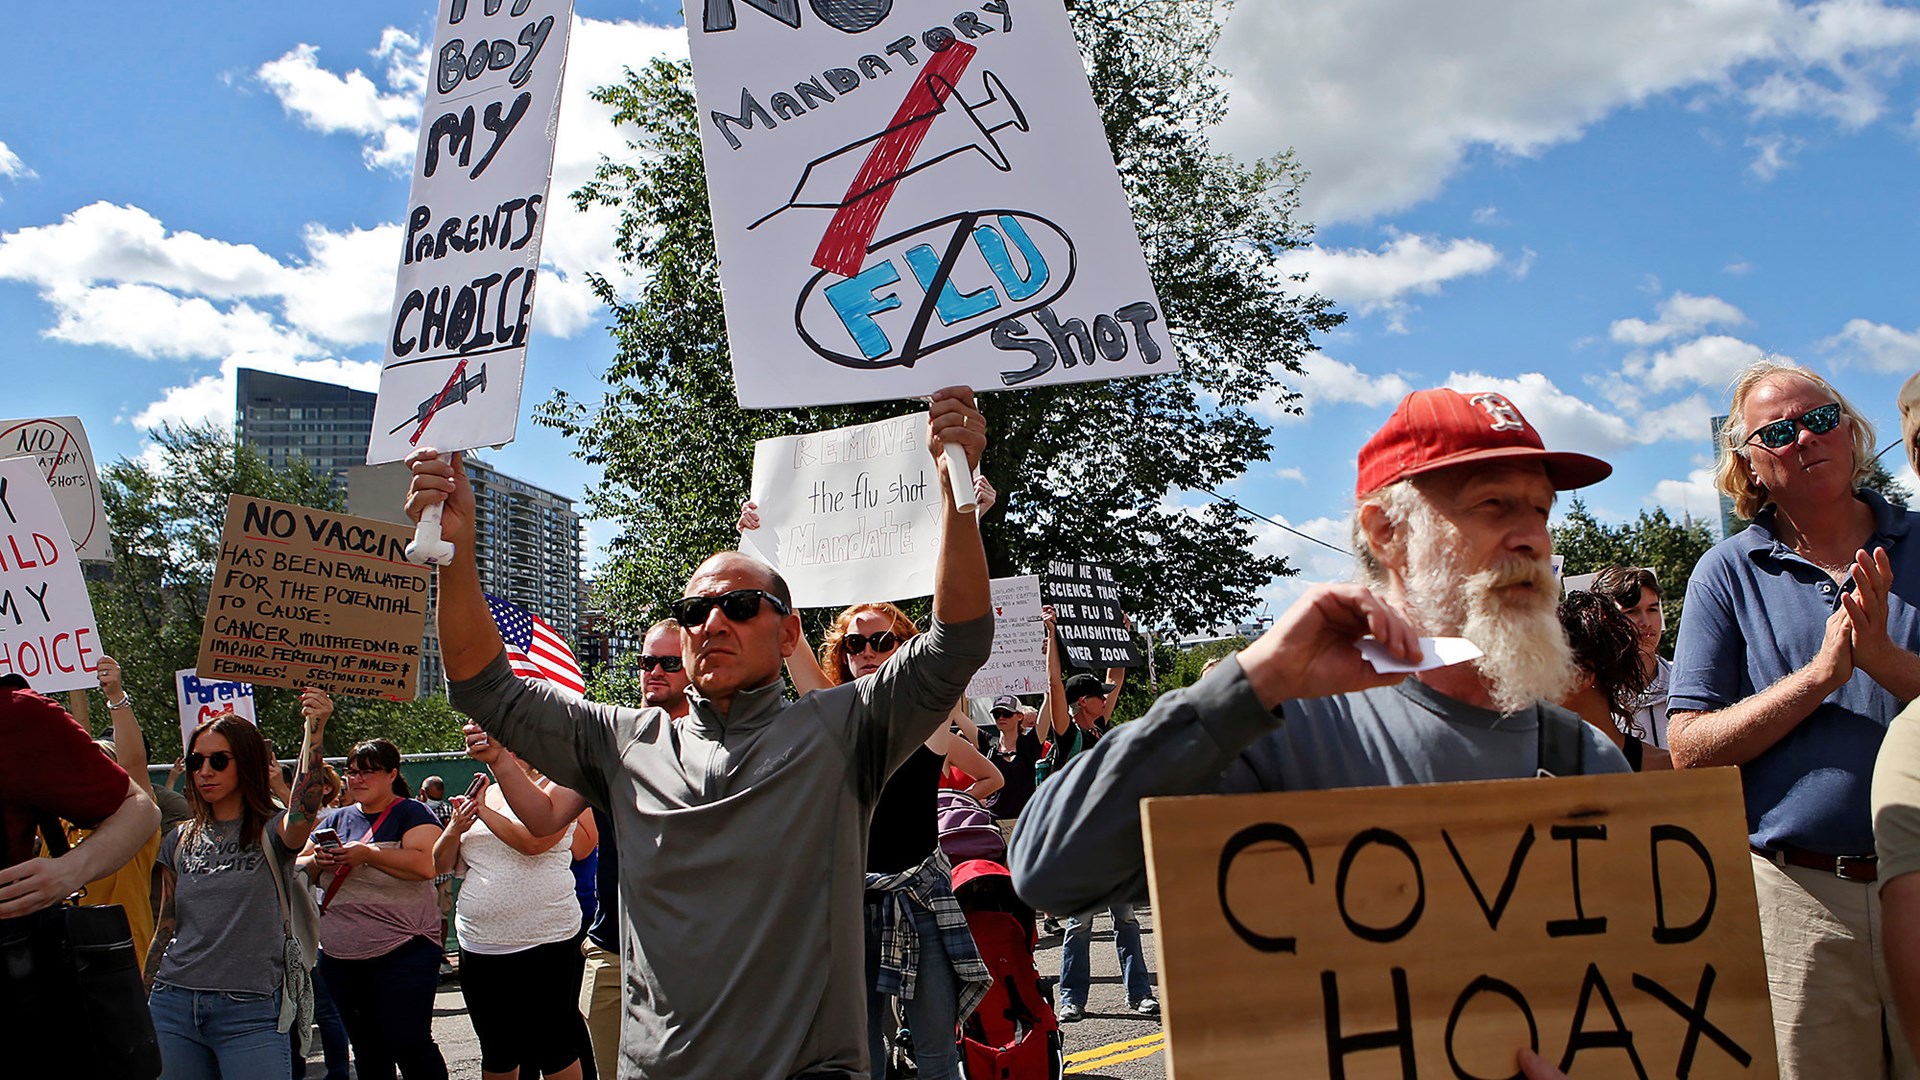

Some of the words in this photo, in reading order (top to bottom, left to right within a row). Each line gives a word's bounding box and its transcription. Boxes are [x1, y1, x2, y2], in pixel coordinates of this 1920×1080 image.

[437, 16, 555, 94] BODY
[711, 0, 1013, 150] MANDATORY
[424, 92, 532, 180] MY
[404, 195, 542, 265] PARENTS
[824, 213, 1051, 360] FLU
[393, 267, 537, 358] CHOICE
[17, 429, 55, 452] NO
[793, 417, 917, 469] REMOVE
[39, 452, 77, 467] ATORY
[49, 475, 86, 488] SHOTS
[808, 481, 844, 514] the
[851, 472, 879, 510] flu
[887, 471, 927, 505] shot
[0, 476, 17, 524] Y
[243, 502, 296, 538] NO
[304, 514, 415, 562] VACCIN
[0, 533, 59, 572] ILD
[221, 541, 267, 567] HAS
[1048, 560, 1074, 578] SHOW
[1080, 565, 1092, 579] ME
[1096, 567, 1114, 581] THE
[224, 569, 274, 599] FOR
[281, 580, 319, 601] THE
[324, 586, 422, 615] POTENTIAL
[1049, 582, 1093, 598] SCIENCE
[1097, 586, 1118, 600] THAT
[218, 595, 246, 610] TO
[256, 600, 330, 625] CAUSE:
[1053, 603, 1076, 618] THE
[1081, 605, 1100, 620] FLU
[1104, 606, 1114, 620] IS
[402, 645, 419, 655] OR
[1057, 625, 1131, 641] TRANSMITTED
[0, 628, 98, 677] HOICE
[210, 639, 269, 659] IMPAIR
[271, 647, 338, 670] FERTILITY
[341, 656, 357, 668] OF
[359, 659, 399, 672] MALES
[213, 658, 287, 678] FEMALES!
[1067, 646, 1093, 660] OVER
[1100, 647, 1130, 661] ZOOM
[306, 668, 355, 683] SECTION
[381, 678, 395, 686] ON
[398, 680, 406, 689] A
[342, 687, 383, 697] INSERT
[1217, 822, 1718, 955] COVID
[1321, 963, 1752, 1080] HOAX
